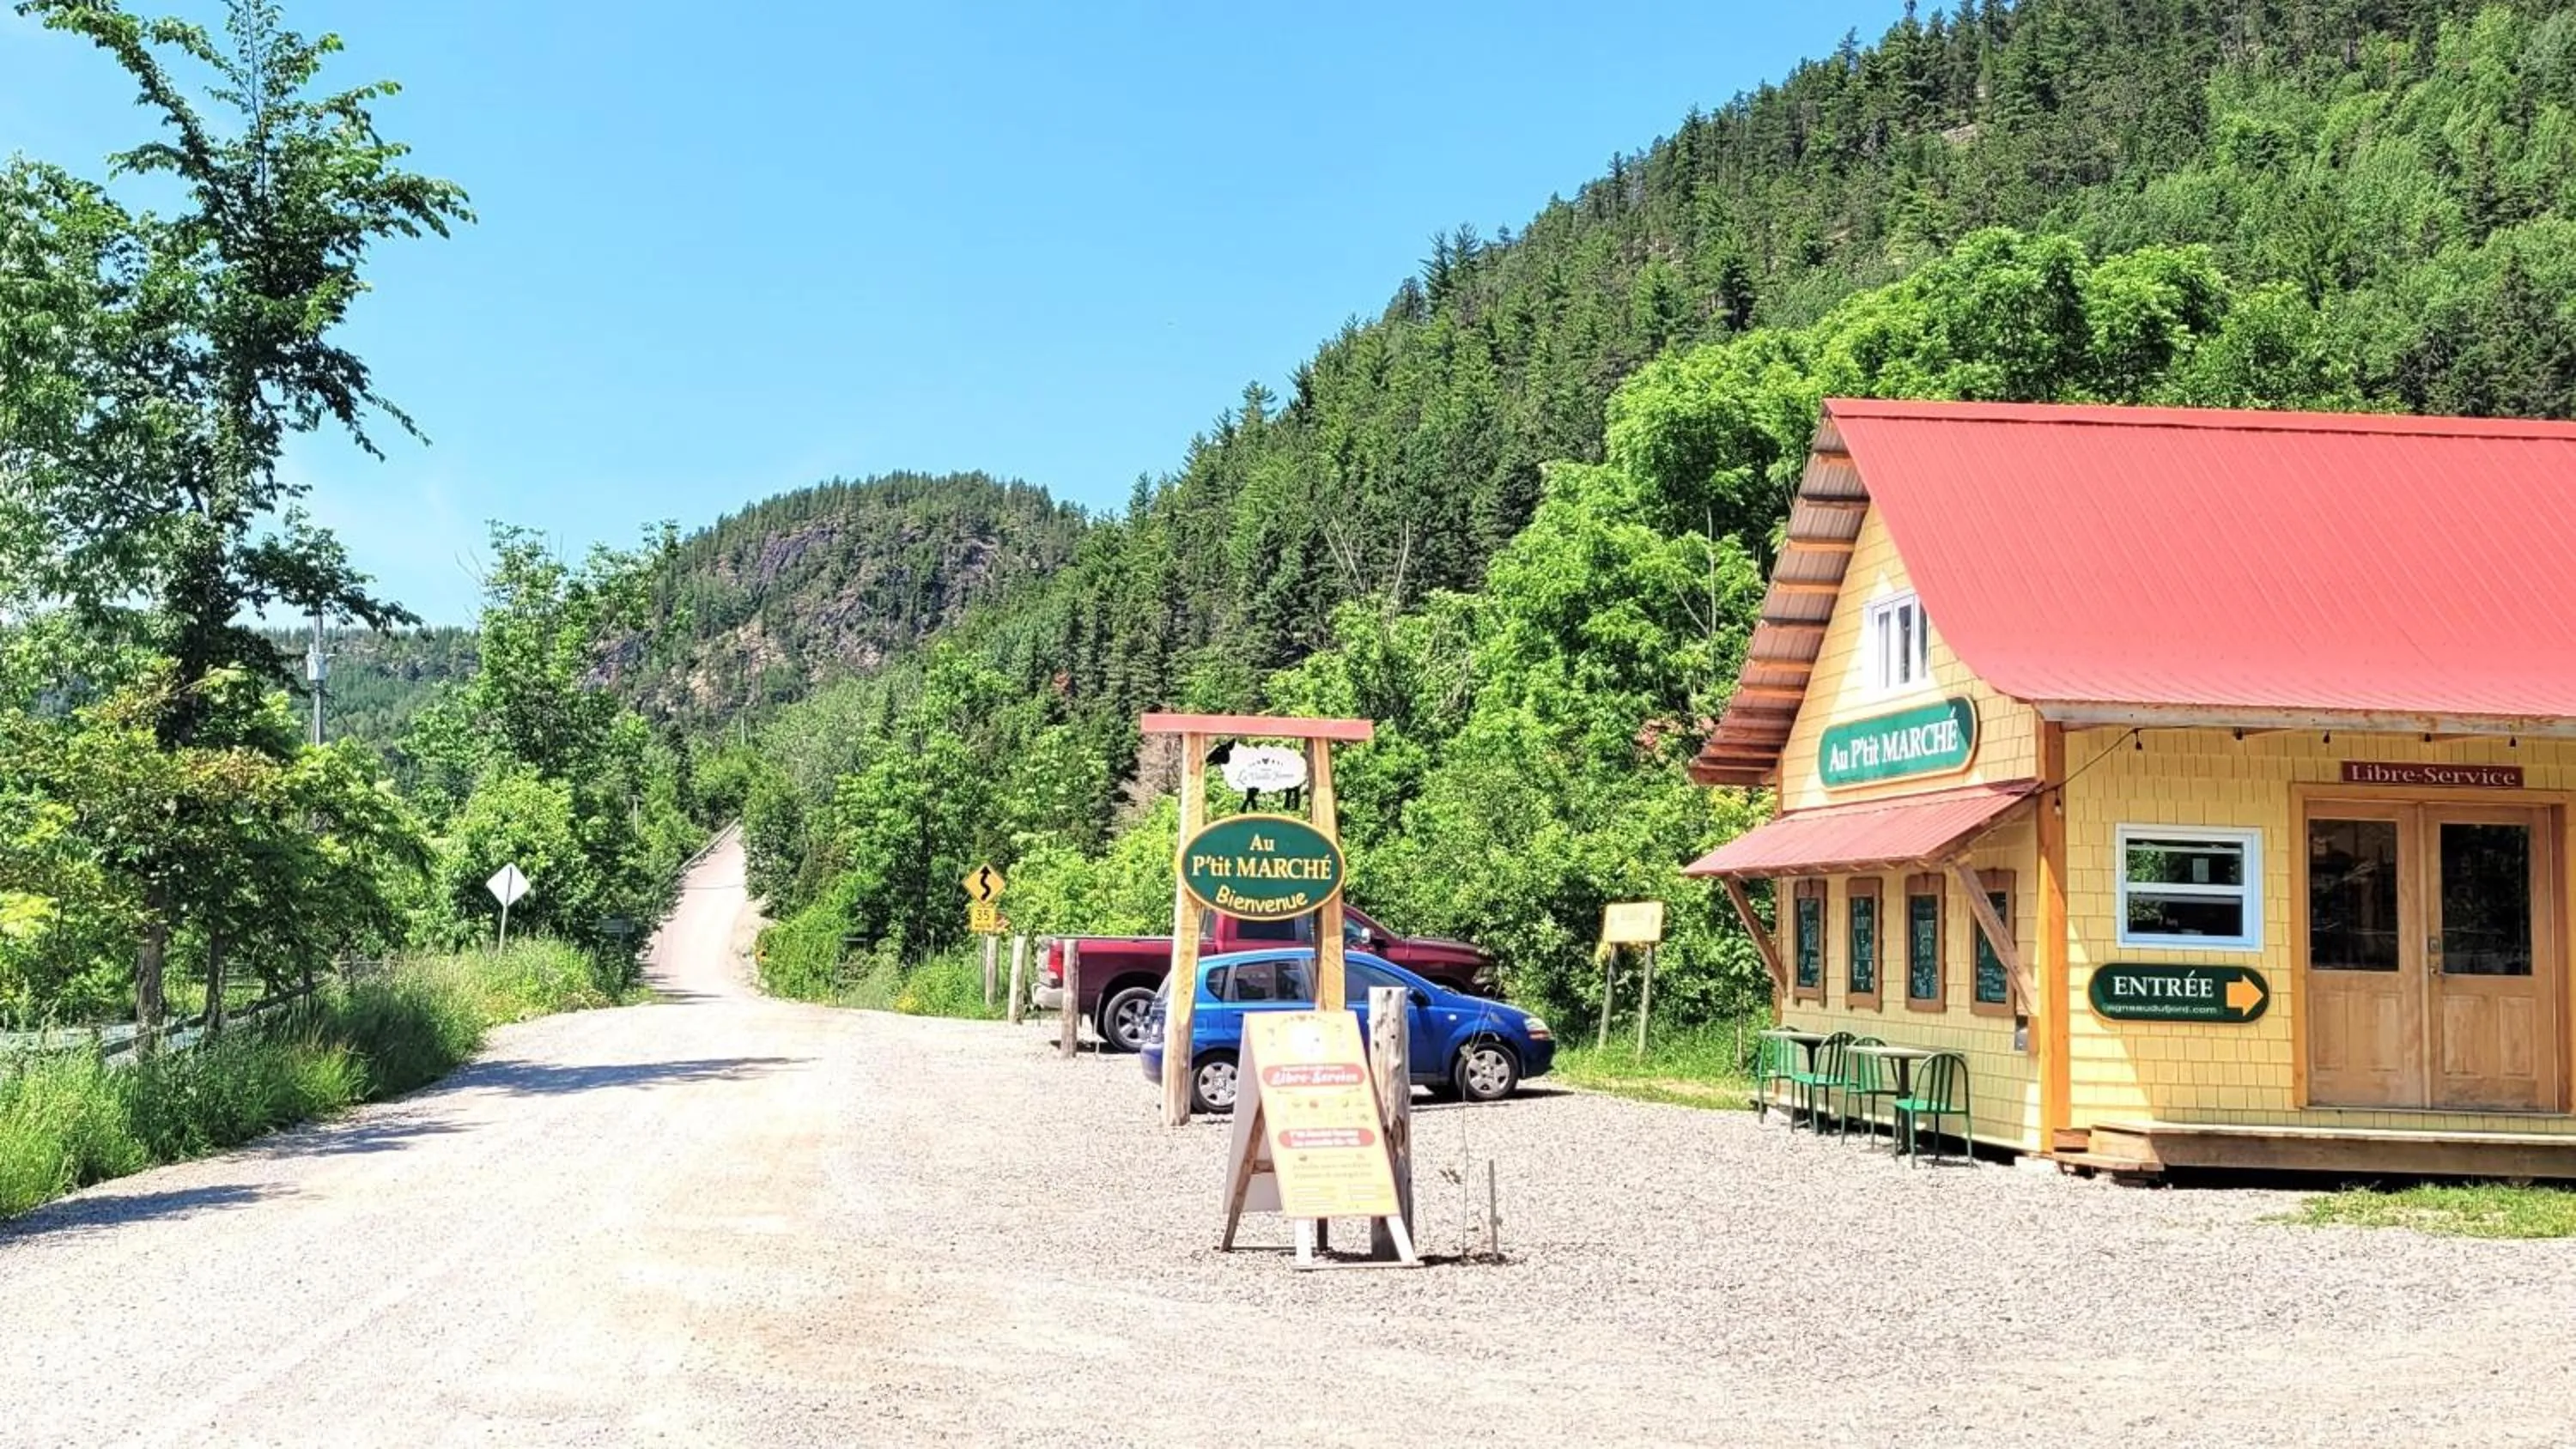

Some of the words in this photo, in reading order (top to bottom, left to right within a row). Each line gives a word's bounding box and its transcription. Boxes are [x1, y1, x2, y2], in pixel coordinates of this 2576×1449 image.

[1829, 743, 1848, 772] Au
[1851, 736, 1879, 768] P'tit
[1881, 706, 1959, 763] MARCHÉ
[2351, 764, 2515, 785] Libre-Service
[1249, 834, 1275, 852] Au
[1192, 855, 1232, 876] P'tit
[1236, 854, 1332, 880] MARCHÉ
[1216, 884, 1309, 912] Bienvenue
[975, 910, 990, 921] 35
[2113, 969, 2214, 997] ENTRÉE
